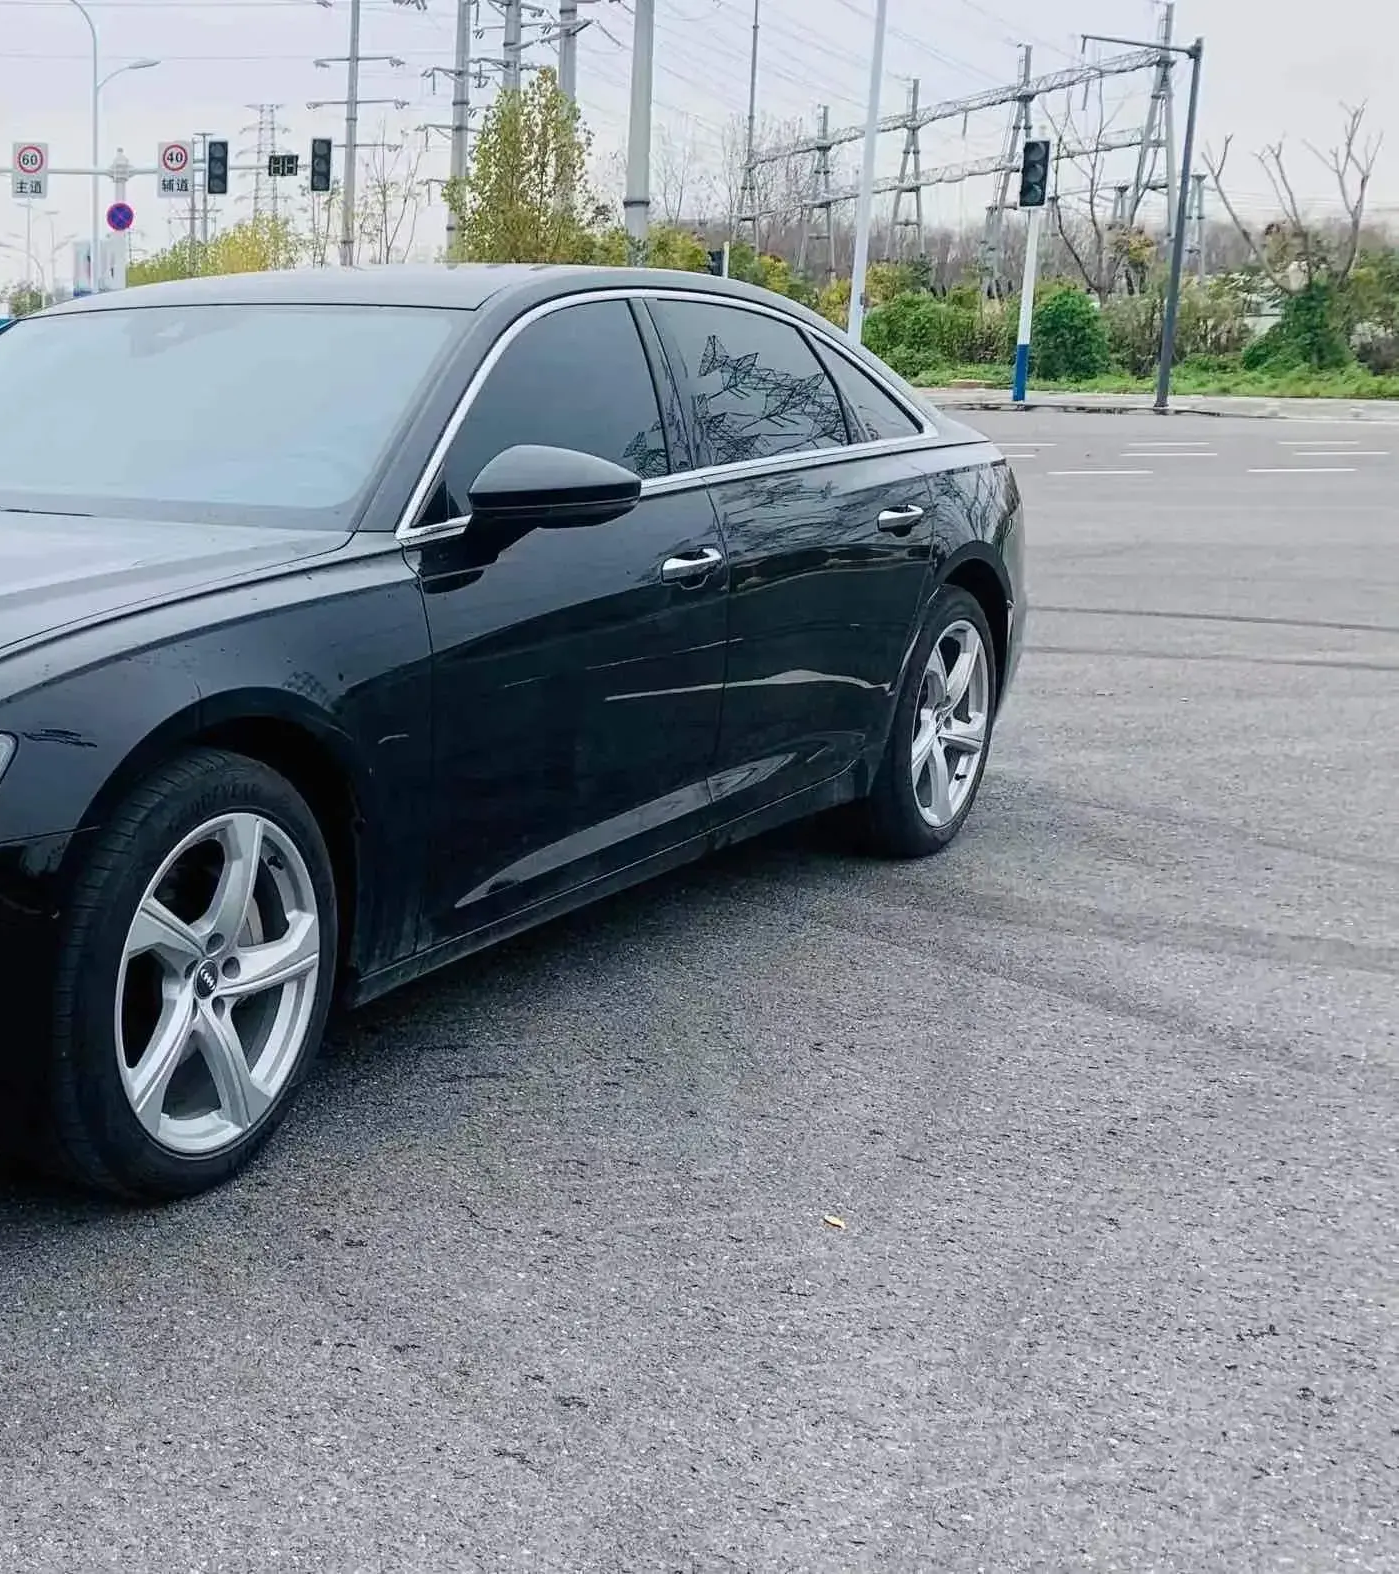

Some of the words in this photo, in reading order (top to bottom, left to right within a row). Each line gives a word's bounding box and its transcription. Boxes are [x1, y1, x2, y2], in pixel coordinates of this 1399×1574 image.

[22, 153, 38, 166] 60
[166, 151, 183, 163] 40
[16, 180, 42, 193] 主道
